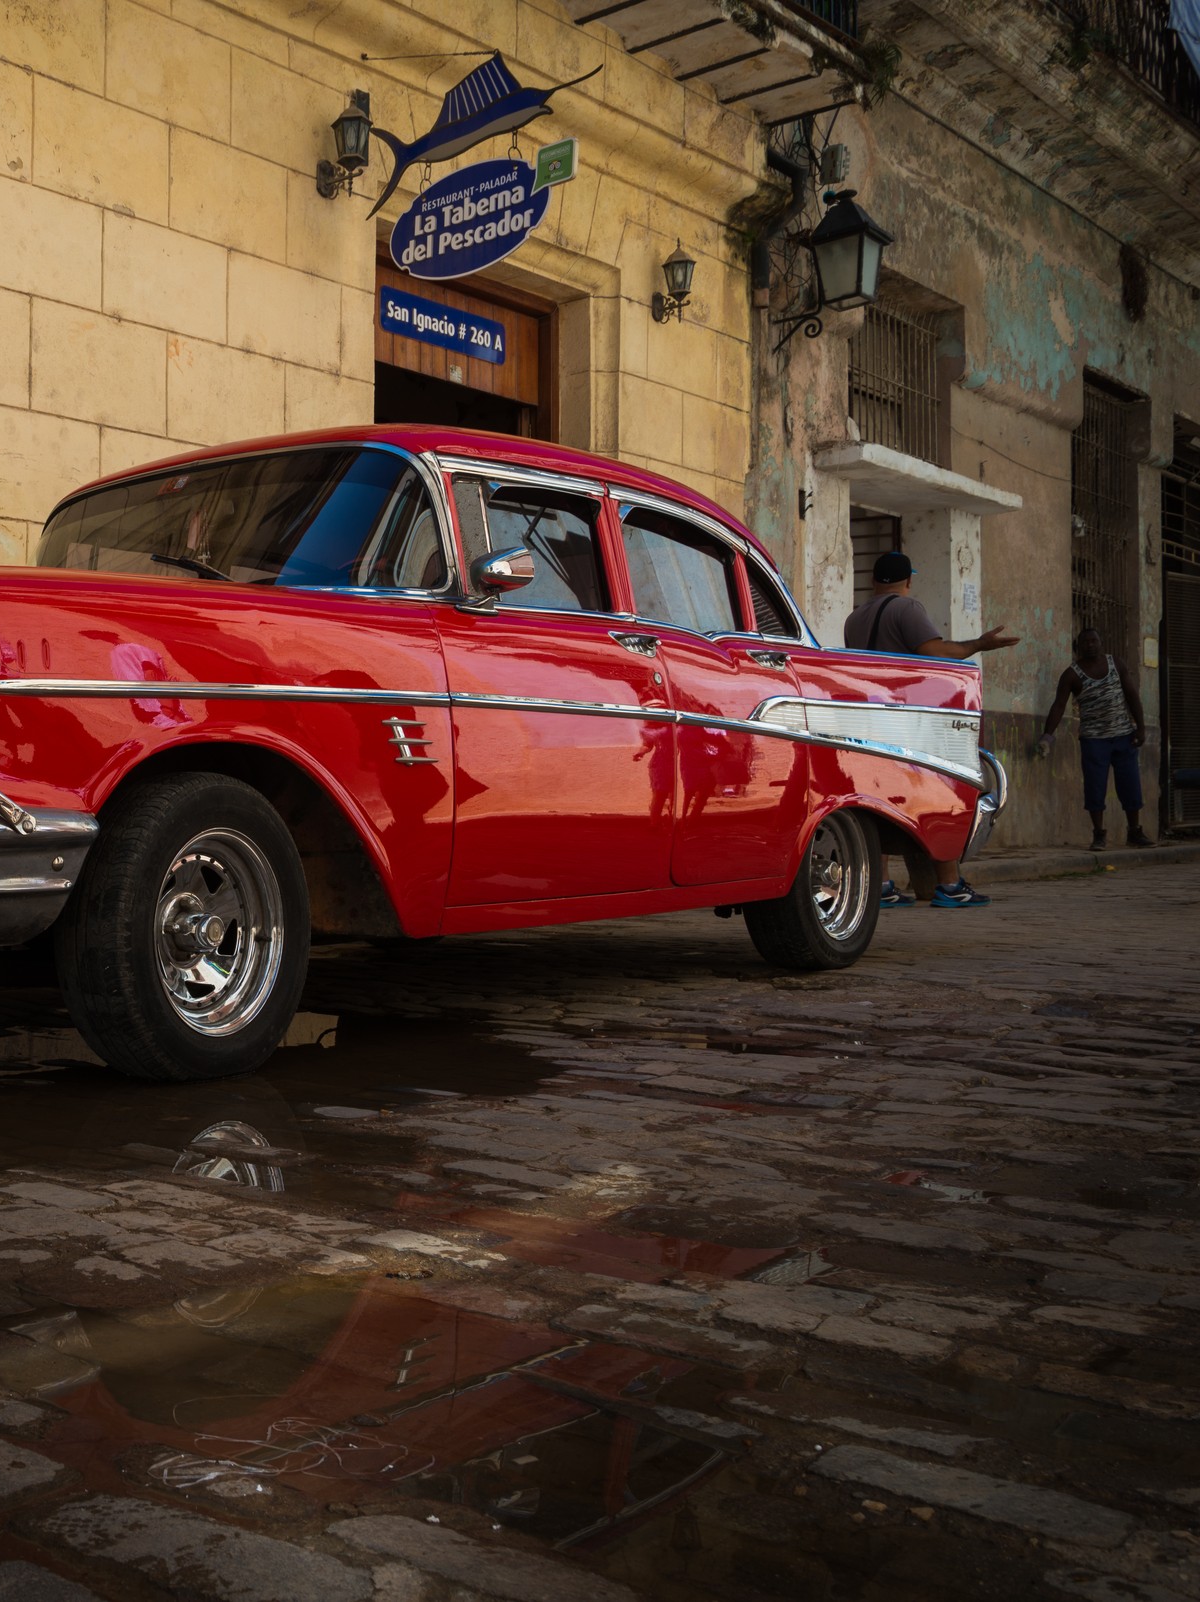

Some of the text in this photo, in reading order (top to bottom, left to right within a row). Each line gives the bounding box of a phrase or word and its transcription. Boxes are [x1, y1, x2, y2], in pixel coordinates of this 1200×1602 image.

[401, 208, 534, 265] del Pescador
[414, 185, 525, 237] La Taberna
[387, 300, 503, 352] San Ignacio # 260 A
